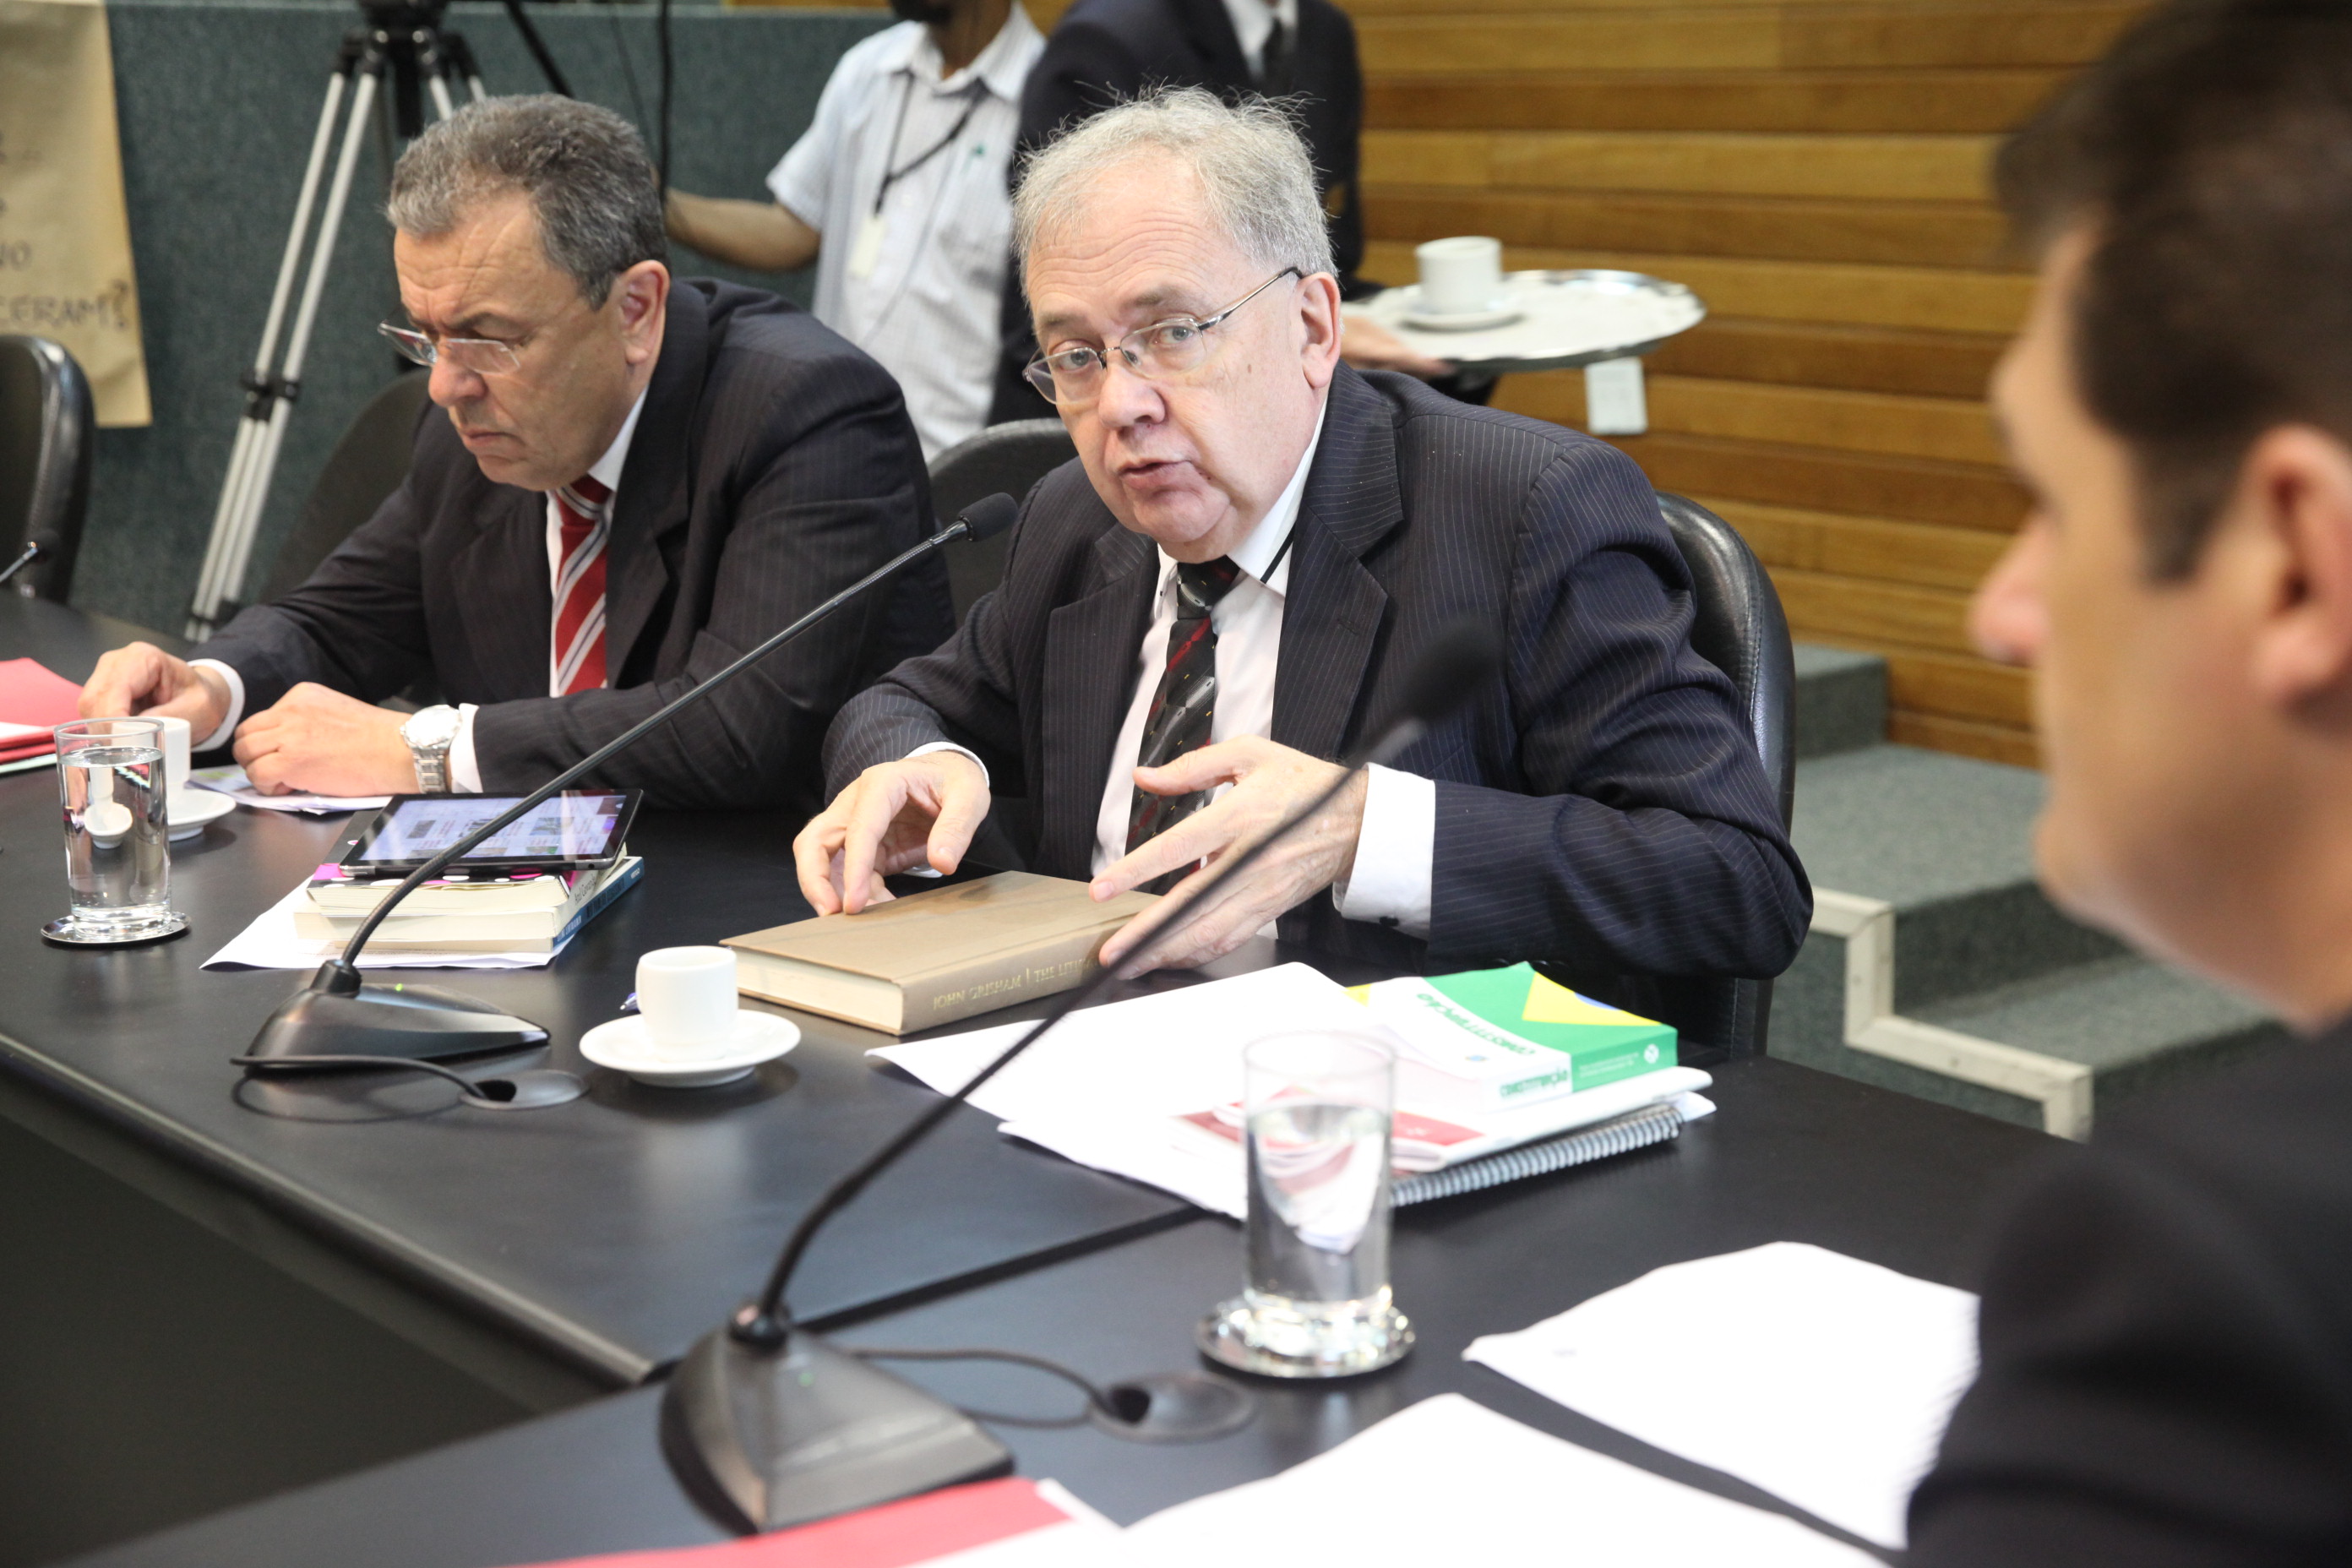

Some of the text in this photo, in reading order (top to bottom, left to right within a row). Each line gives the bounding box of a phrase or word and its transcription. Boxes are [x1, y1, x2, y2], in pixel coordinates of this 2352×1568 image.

[933, 989, 966, 1010] JOHN
[969, 974, 1022, 1000] GRISHAM
[1033, 966, 1055, 983] THE
